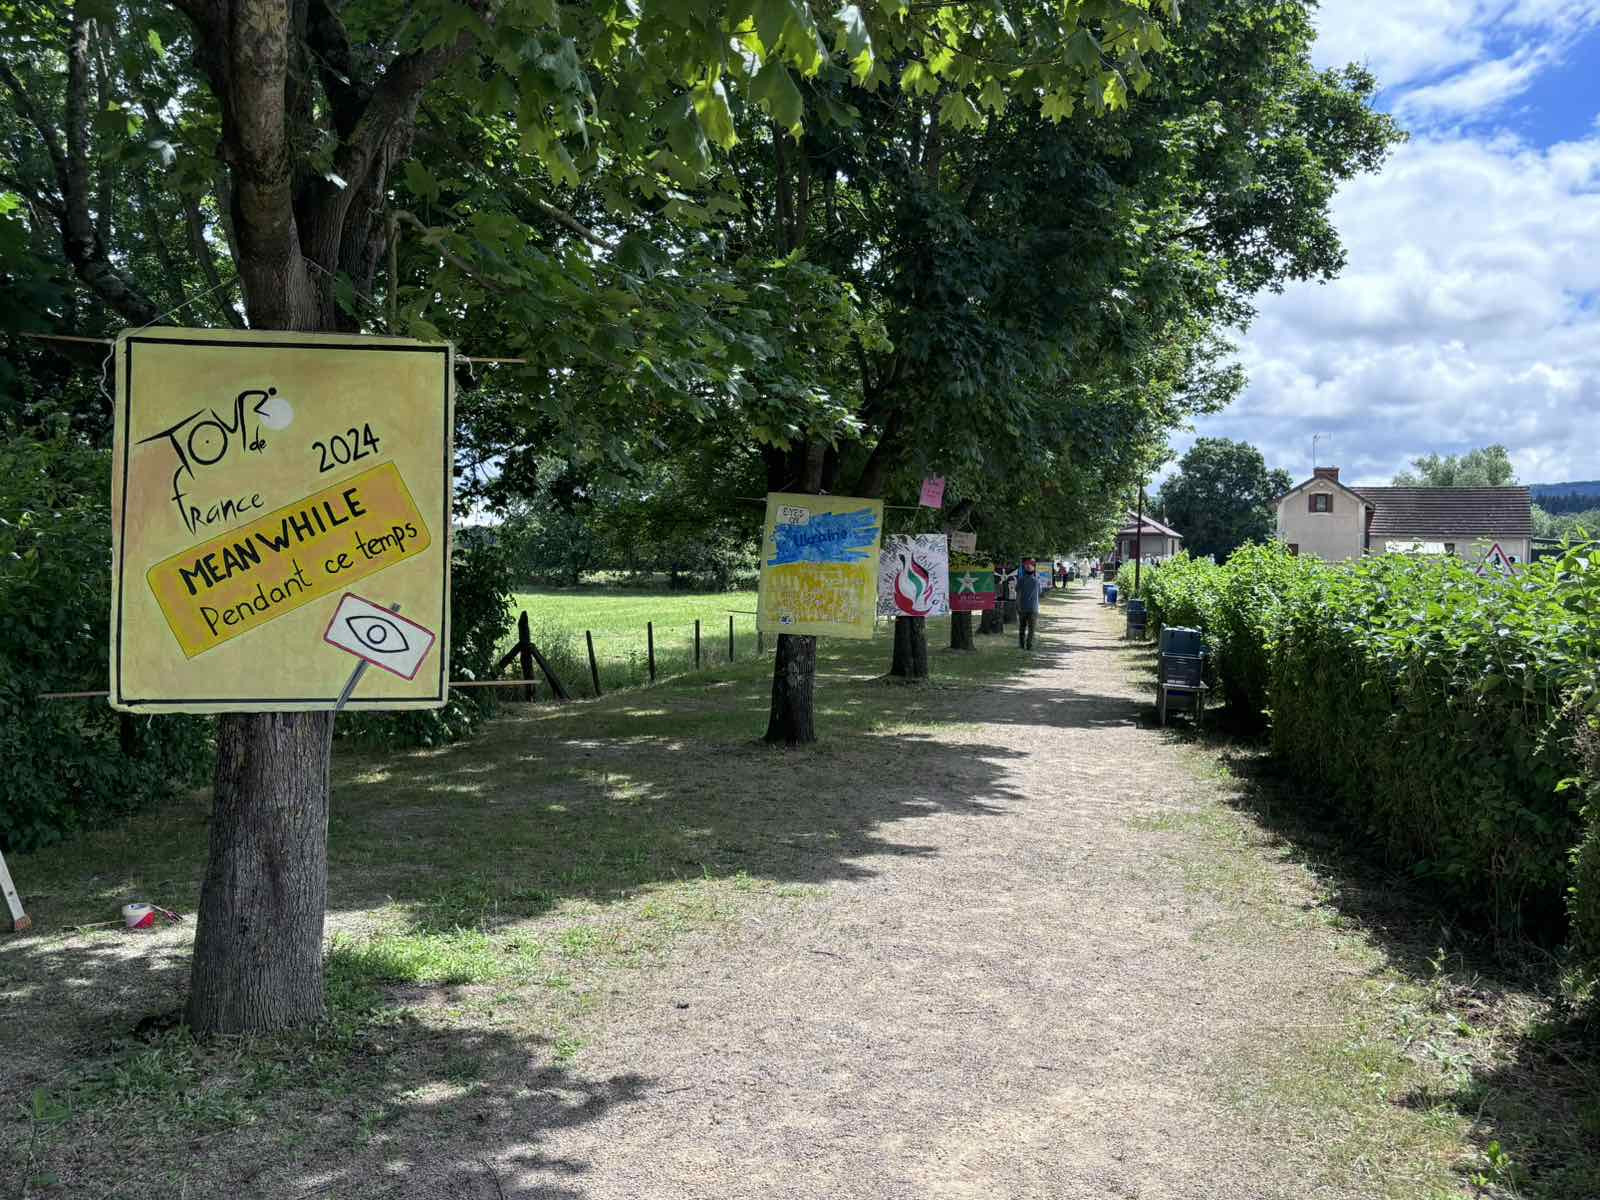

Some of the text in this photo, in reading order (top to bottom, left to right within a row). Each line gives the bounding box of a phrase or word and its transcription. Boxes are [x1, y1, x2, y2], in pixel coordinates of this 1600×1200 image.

[136, 387, 277, 480] TOUR
[249, 426, 268, 454] de
[312, 423, 380, 473] 2024
[178, 488, 367, 596] MEANWHILE
[200, 521, 418, 637] Pendant ce temps
